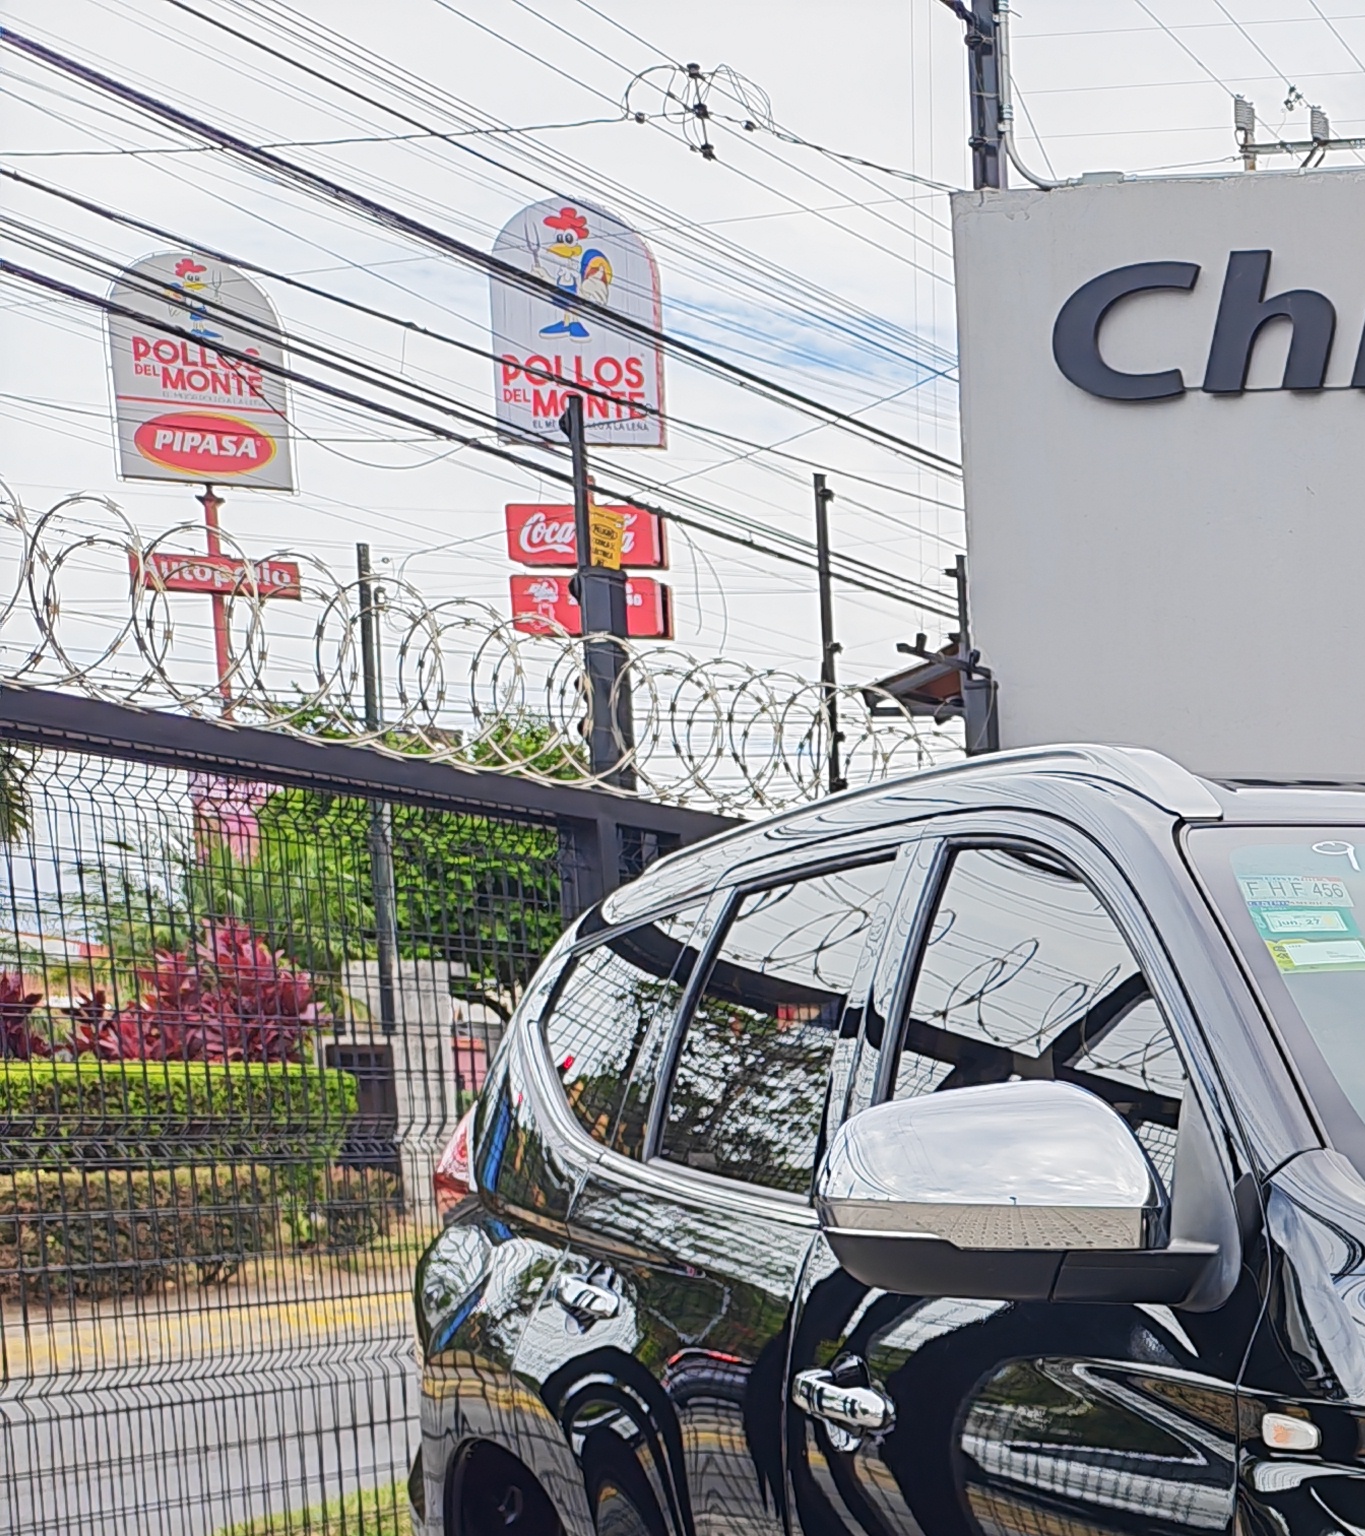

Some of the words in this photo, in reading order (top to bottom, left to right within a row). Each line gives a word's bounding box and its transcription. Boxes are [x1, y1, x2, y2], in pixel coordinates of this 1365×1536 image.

[134, 363, 160, 377] DEL
[502, 353, 646, 389] POLLOS
[162, 367, 265, 398] MONTE
[503, 387, 531, 403] DEL
[154, 429, 258, 459] PIPASA
[1312, 882, 1344, 898] 456
